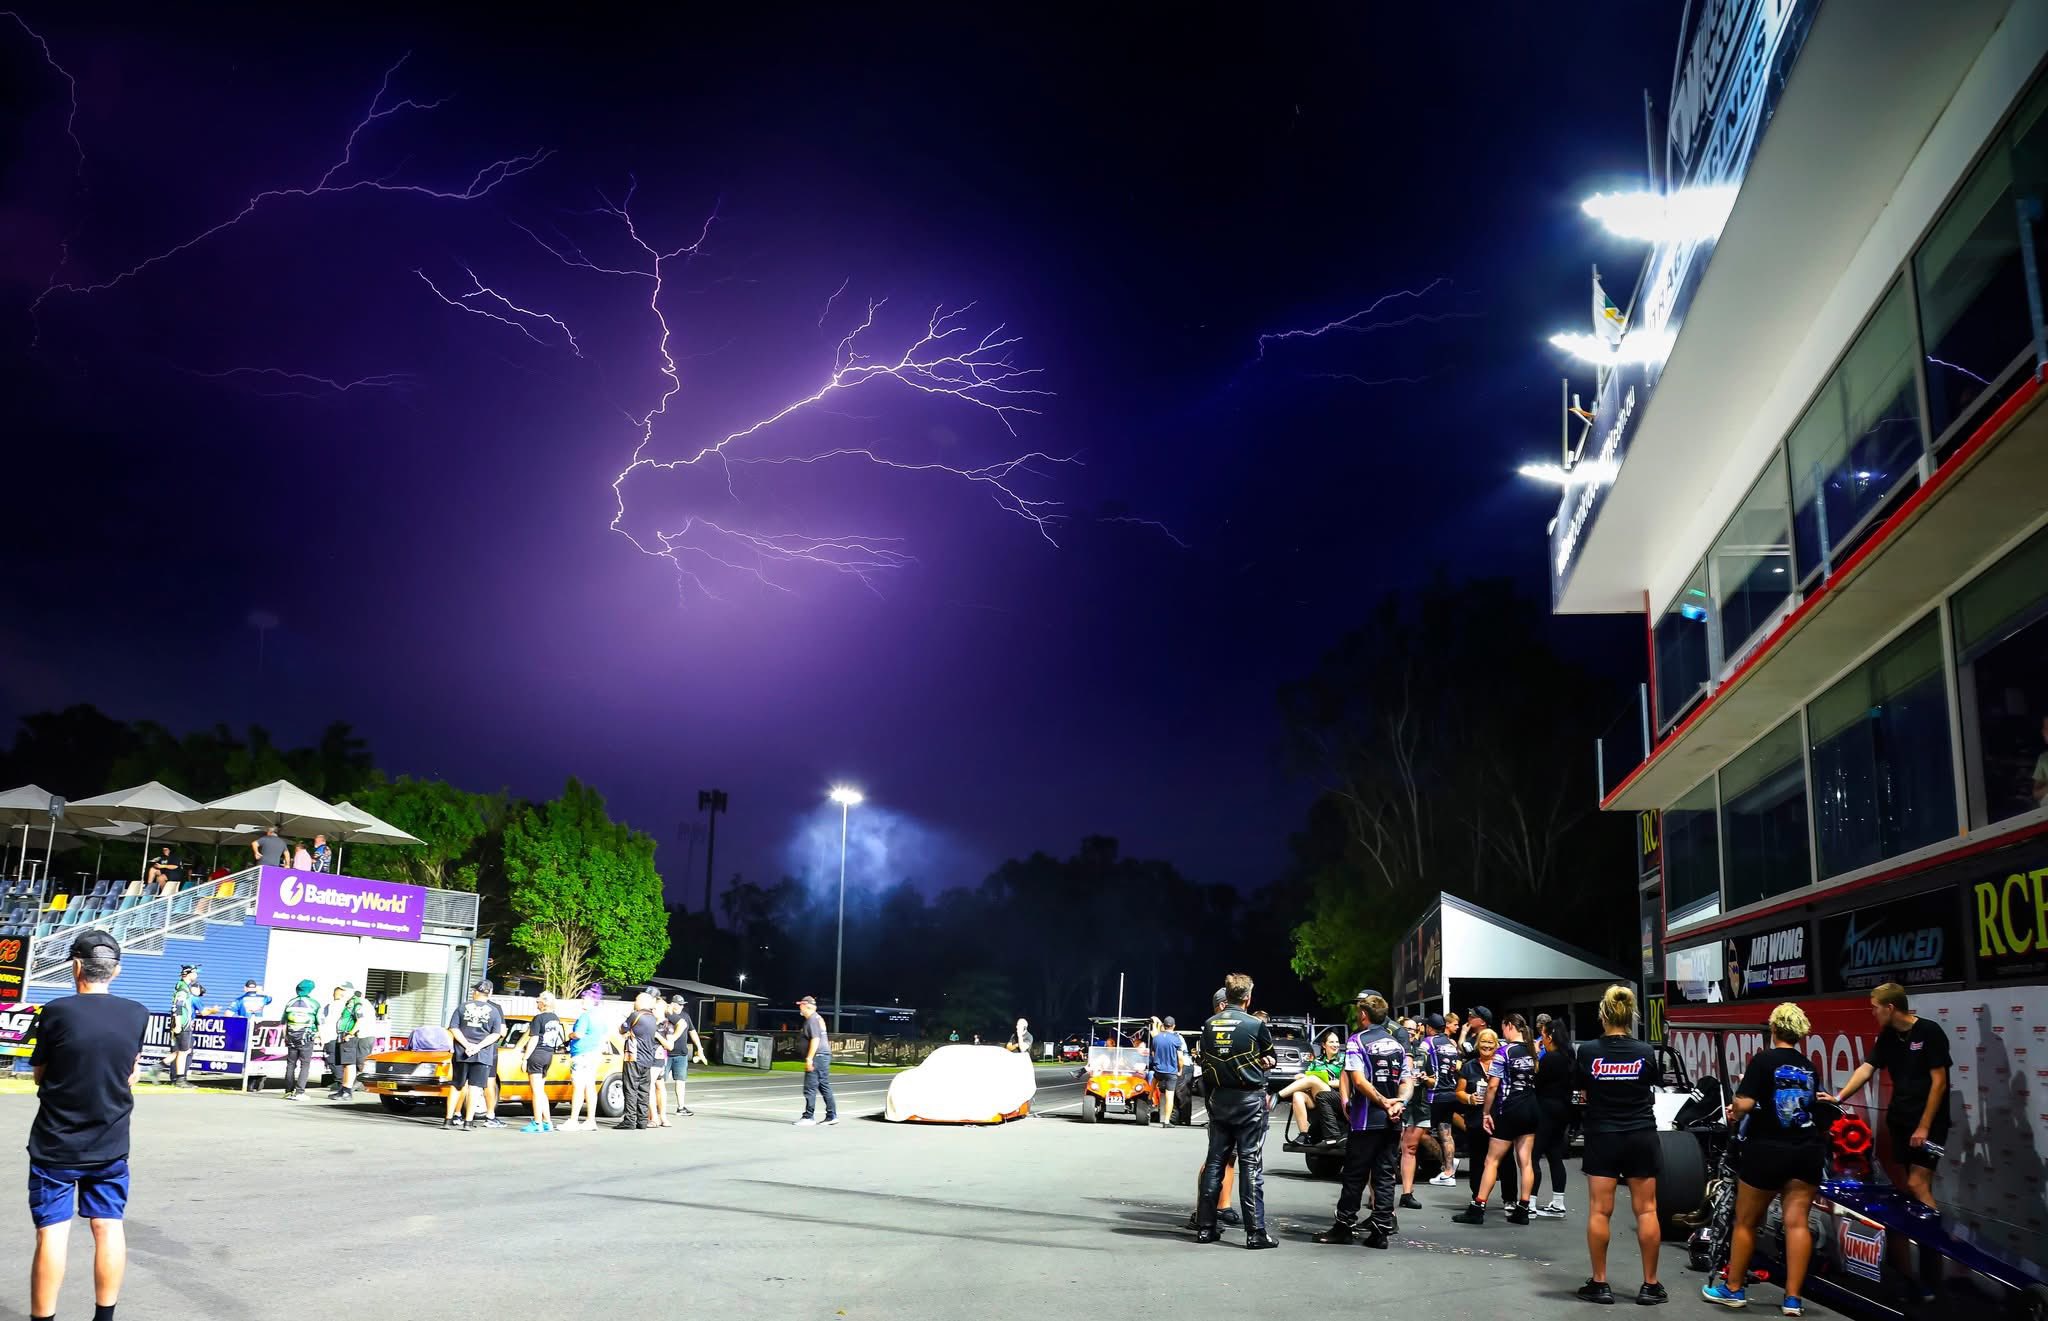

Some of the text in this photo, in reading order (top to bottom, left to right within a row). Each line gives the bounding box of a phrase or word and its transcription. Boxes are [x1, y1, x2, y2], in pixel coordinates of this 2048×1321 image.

[1642, 809, 1659, 855] RC
[304, 884, 407, 914] BatteryWorld
[1751, 926, 1804, 966] MR WONG
[1842, 911, 1945, 971] ADVANCED
[164, 1016, 226, 1033] ERICAL
[163, 1031, 226, 1049] ITRIES
[845, 1038, 866, 1051] Alley
